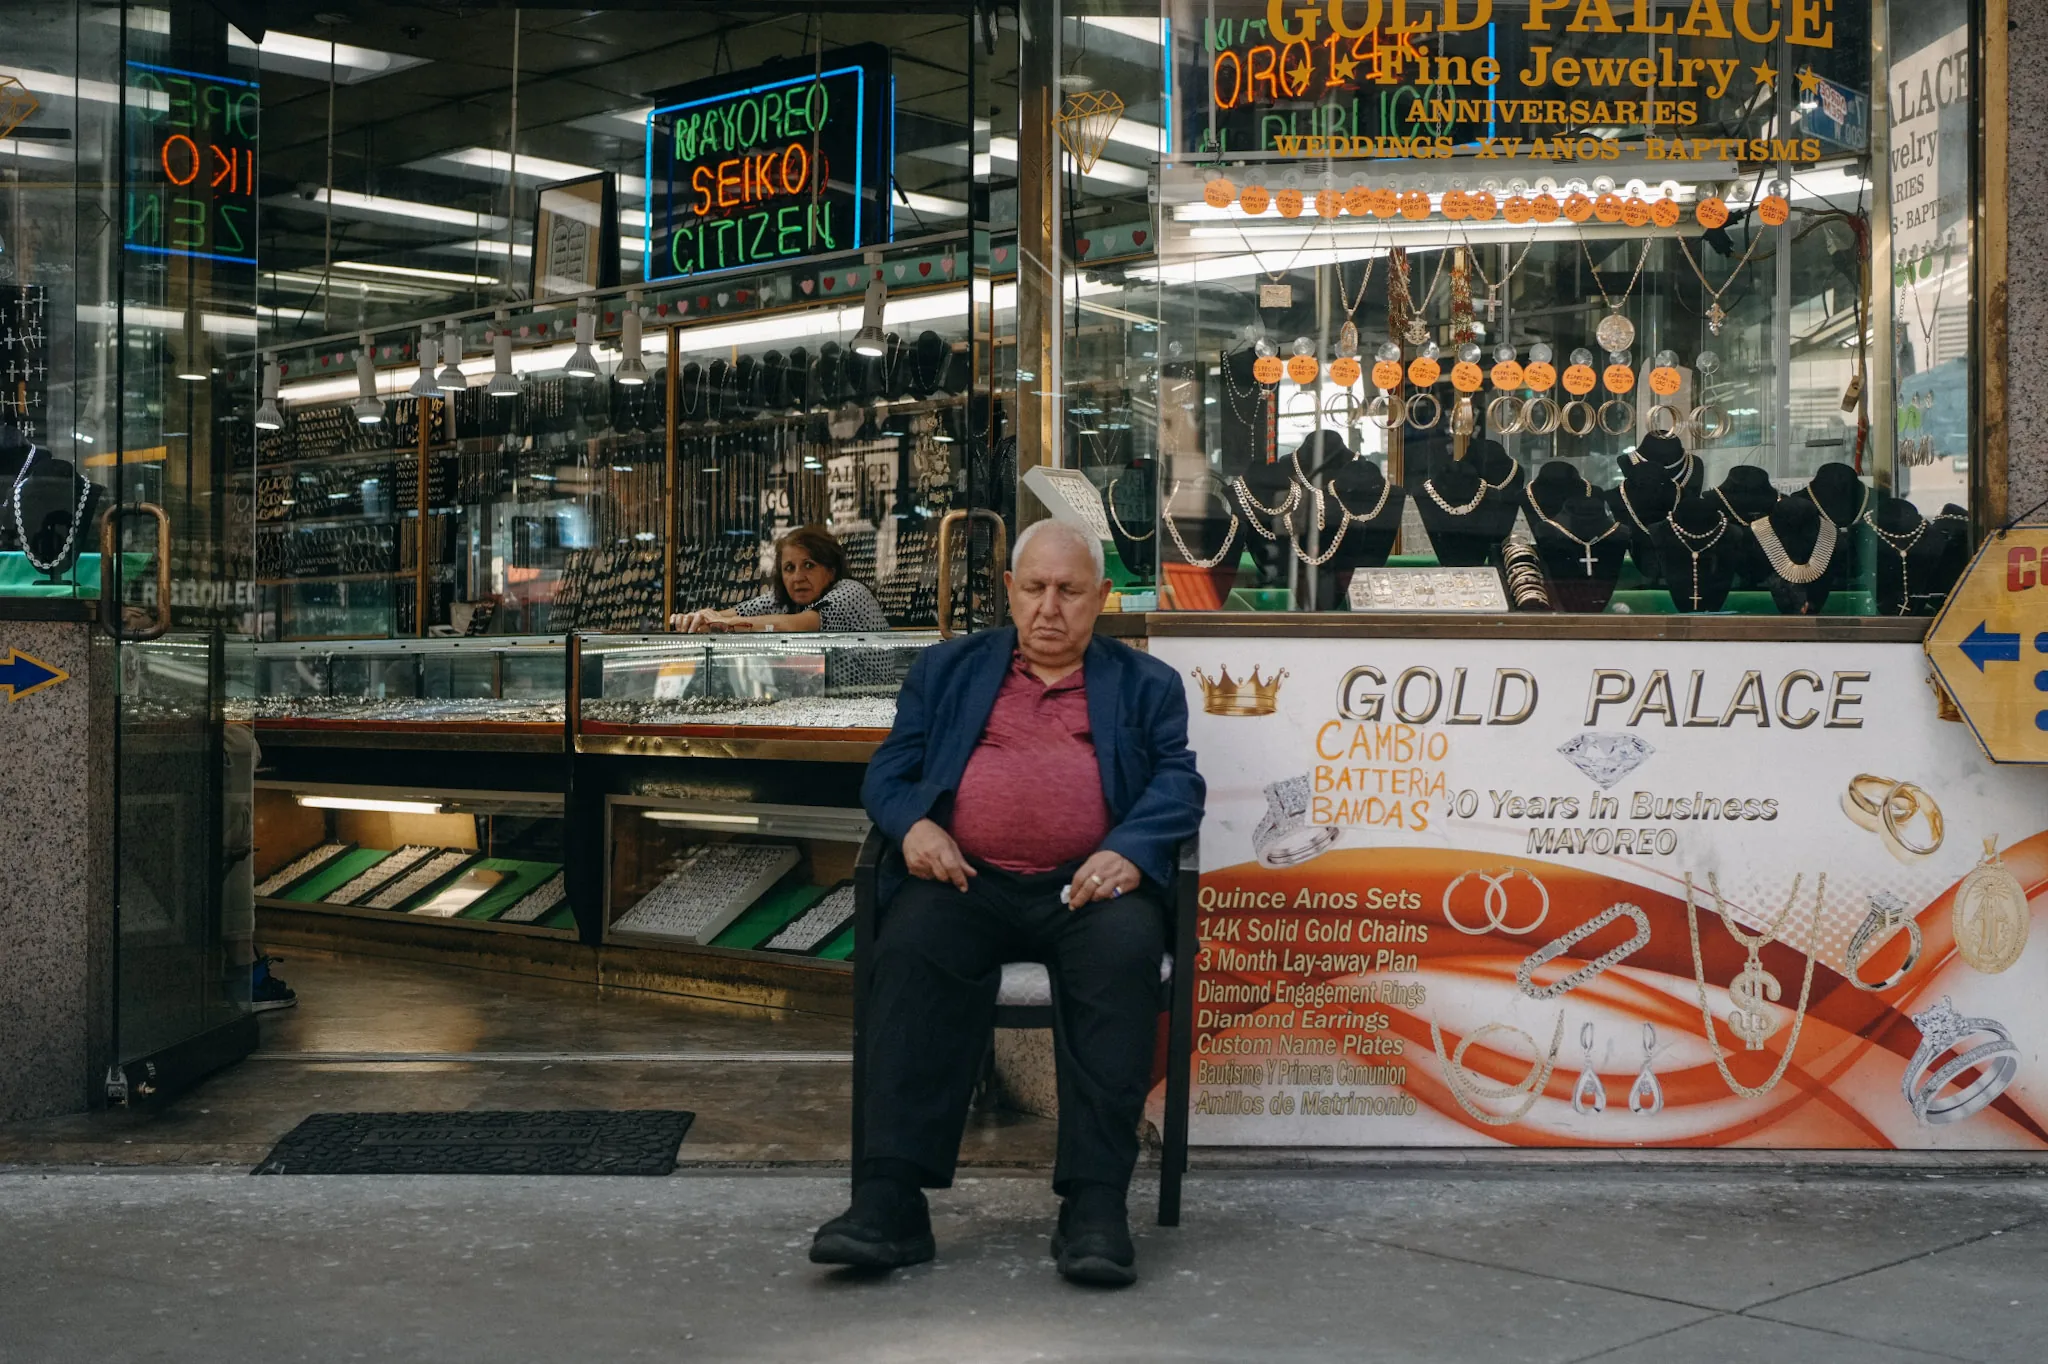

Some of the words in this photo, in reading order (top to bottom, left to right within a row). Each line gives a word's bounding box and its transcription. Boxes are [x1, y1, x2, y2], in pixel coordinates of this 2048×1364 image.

[1266, 0, 1493, 44] GOLD
[1522, 0, 1834, 49] PALACE
[1214, 42, 1311, 109] ORO
[1374, 45, 1501, 87] Fine
[1519, 47, 1740, 99] Jewelry
[676, 82, 829, 162] MAYOREO
[1405, 100, 1698, 126] ANNIVERSARIES
[1274, 136, 1453, 159] WEDDINGS
[1475, 137, 1526, 160] XV
[1528, 137, 1620, 161] ANOS
[1645, 137, 1822, 162] BAPTISMS
[692, 143, 808, 216] SEIKO
[672, 202, 836, 273] CITIZEN
[1336, 665, 1539, 726] GOLD
[1583, 668, 1872, 730] PALACE
[1315, 719, 1449, 763] CAMBIO
[1312, 796, 1431, 832] BANDAS
[1489, 789, 1579, 821] Years
[1590, 790, 1618, 820] in
[1630, 792, 1779, 822] Business
[1526, 828, 1678, 856] MAYOREO
[1197, 886, 1287, 912] Quince
[1293, 887, 1358, 910] Anos
[1365, 888, 1422, 910] Sets
[1198, 918, 1242, 942] 14K
[1247, 918, 1299, 942] Solid
[1305, 919, 1352, 943] Gold
[1358, 919, 1429, 944] Chains
[1199, 947, 1212, 972] 3
[1217, 948, 1278, 972] Month
[1283, 949, 1371, 977] Lay-away
[1375, 949, 1418, 973] Plan
[1198, 979, 1272, 1004] Diamond
[1275, 980, 1377, 1008] Engagement
[1380, 980, 1426, 1009] Rings
[1197, 1009, 1295, 1029] Diamond
[1302, 1010, 1390, 1033] Earrings
[1197, 1033, 1272, 1055] Custom
[1278, 1033, 1337, 1056] Name
[1343, 1034, 1404, 1056] Plates
[1197, 1059, 1263, 1085] Bautismo
[1279, 1060, 1333, 1085] Primera
[1337, 1060, 1407, 1086] Comunion
[1269, 1092, 1296, 1115] de
[1300, 1092, 1417, 1117] Matrimonio
